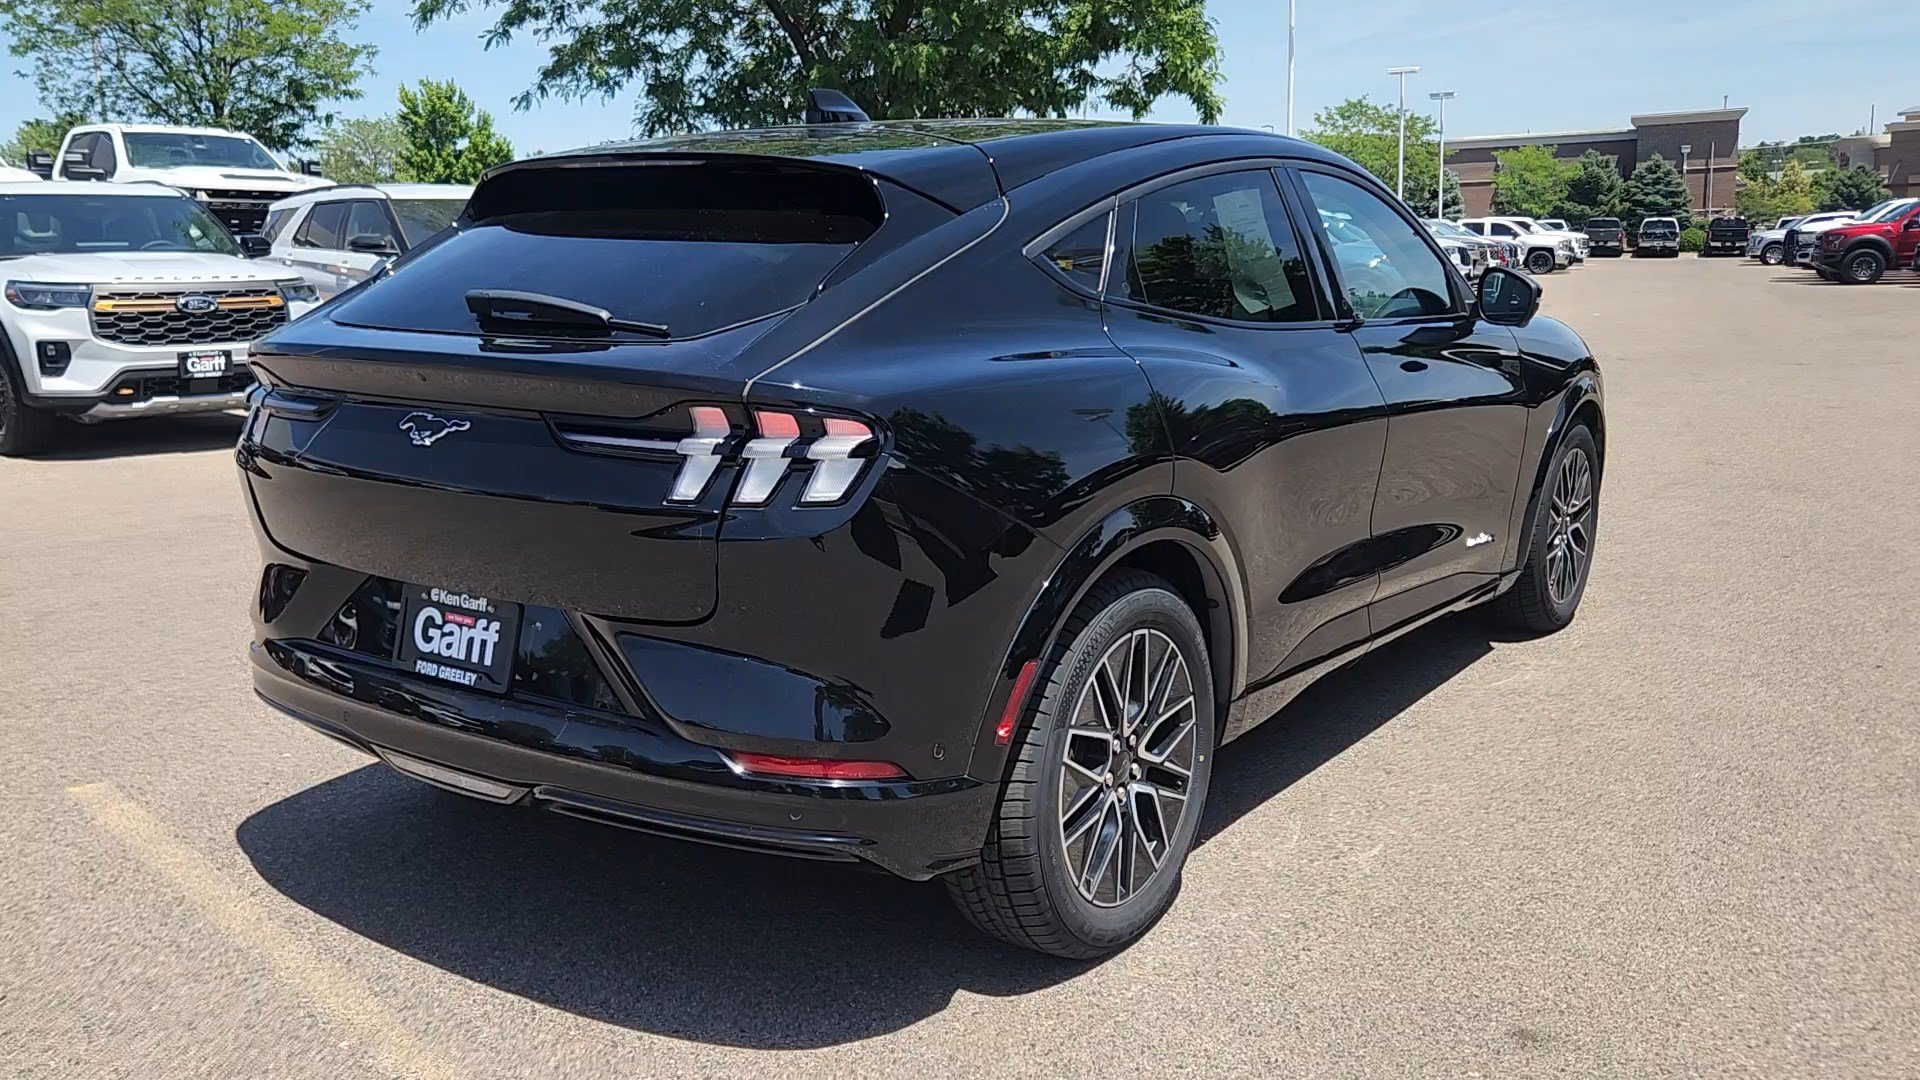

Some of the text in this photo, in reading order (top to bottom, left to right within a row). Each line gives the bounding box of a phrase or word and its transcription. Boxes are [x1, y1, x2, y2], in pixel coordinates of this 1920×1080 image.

[187, 354, 225, 372] Garff
[439, 589, 488, 612] Ken Garff
[414, 606, 501, 667] Garff
[415, 660, 477, 686] FORD GREELEY
